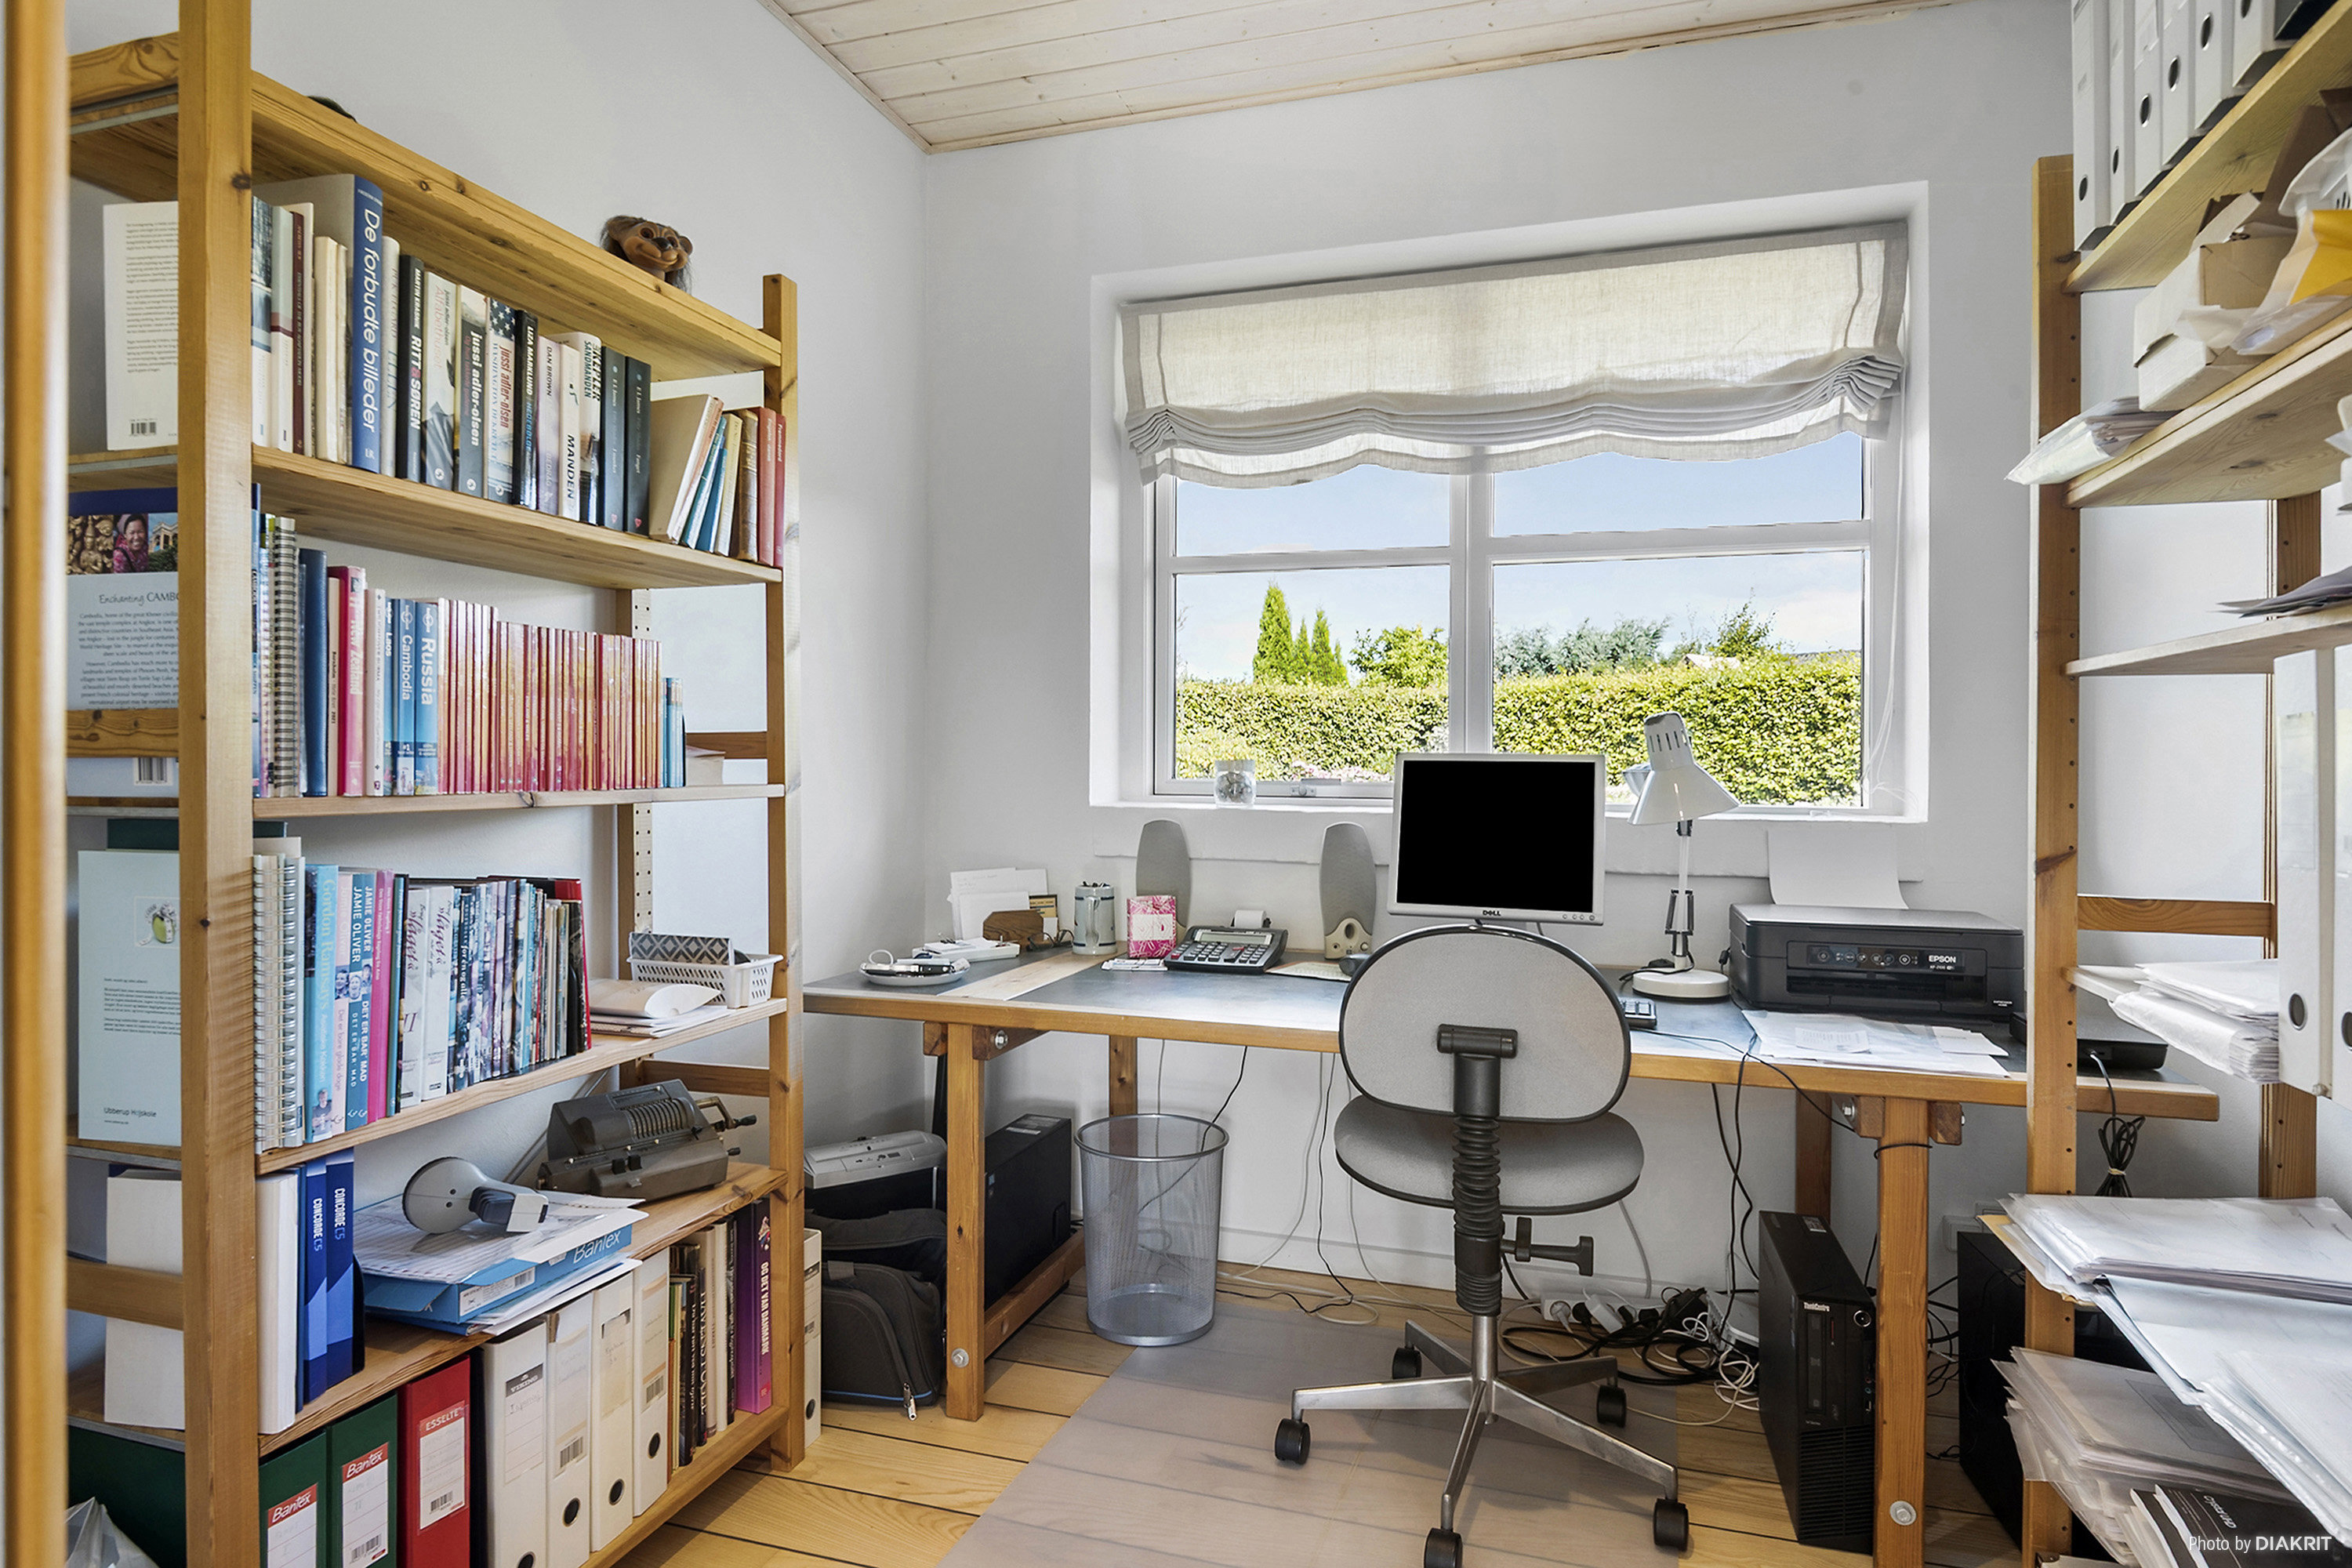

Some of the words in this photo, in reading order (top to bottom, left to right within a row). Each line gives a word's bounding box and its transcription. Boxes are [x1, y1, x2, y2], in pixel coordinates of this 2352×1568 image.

[364, 209, 380, 243] De
[363, 247, 379, 343] forbudte
[442, 289, 452, 306] jussi
[434, 285, 445, 369] Alfabethuset
[442, 307, 451, 346] adler-olsen
[526, 325, 535, 346] LIZA
[470, 331, 483, 366] jussi
[499, 346, 512, 372] jussi
[409, 336, 422, 430] RITT&SØREN
[525, 347, 534, 395] MARKLUND
[583, 340, 593, 398] SANDMANDEN
[362, 347, 379, 433] billeder
[470, 368, 483, 446] adler-olsen
[500, 372, 513, 428] adler-olsen
[567, 434, 575, 499] MANDEN
[99, 593, 144, 607] Enchanting
[350, 620, 363, 646] New
[350, 650, 364, 695] Zealand
[401, 634, 413, 700] Cambodia
[420, 637, 436, 705] Russia
[321, 879, 336, 938] Gordon
[340, 885, 350, 920] Jamie
[353, 886, 363, 920] JAMIE
[364, 885, 373, 915] JAMIE
[339, 922, 349, 957] Oliver
[352, 923, 362, 962] OLIVER
[363, 917, 372, 952] OLIVER
[460, 945, 469, 958] for
[318, 941, 333, 1010] Ramsays
[1929, 955, 1956, 964] EPSON
[320, 1014, 328, 1051] Asiatiske
[351, 1031, 358, 1043] ER
[361, 1022, 368, 1033] ER
[335, 1051, 344, 1070] glade
[359, 1060, 368, 1082] MAD
[335, 1071, 343, 1091] dage
[103, 1107, 129, 1116] Ubberup
[313, 1198, 323, 1239] CONCORDE
[334, 1188, 346, 1228] CONCORDE
[760, 1261, 770, 1276] OG
[760, 1275, 770, 1292] DET
[760, 1292, 770, 1312] VAR
[760, 1311, 770, 1356] DANMARK
[510, 1374, 539, 1393] VIKING
[425, 1409, 460, 1431] ESSELTE
[346, 1450, 383, 1479] Bantex
[271, 1491, 312, 1523] Bantex
